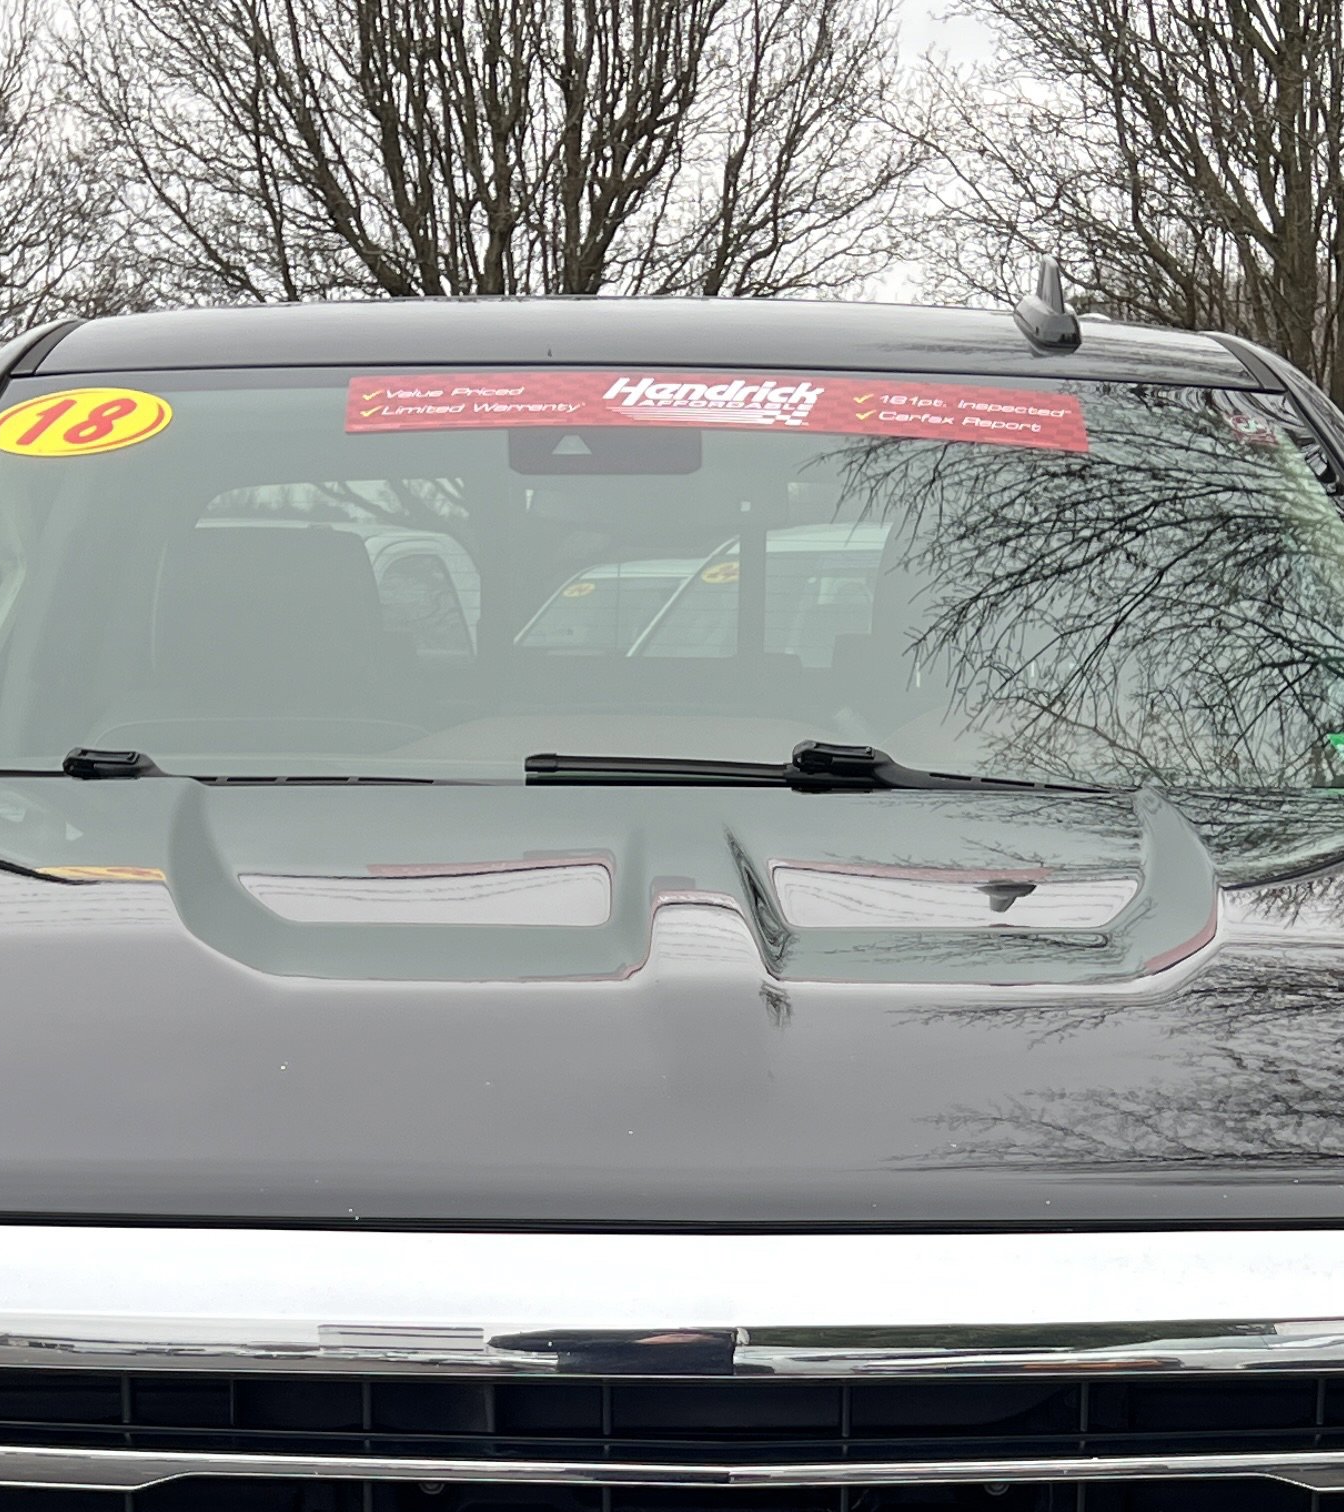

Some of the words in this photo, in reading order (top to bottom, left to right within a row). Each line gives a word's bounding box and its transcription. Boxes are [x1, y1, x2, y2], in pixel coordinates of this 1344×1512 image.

[385, 388, 444, 399] Value
[451, 386, 525, 397] Priced
[602, 377, 825, 406] Hendrick
[381, 403, 465, 416] Limited
[638, 399, 814, 411] AFFORDABLE
[16, 398, 137, 446] 18
[878, 411, 955, 425] Carfax
[962, 416, 1042, 432] Report
